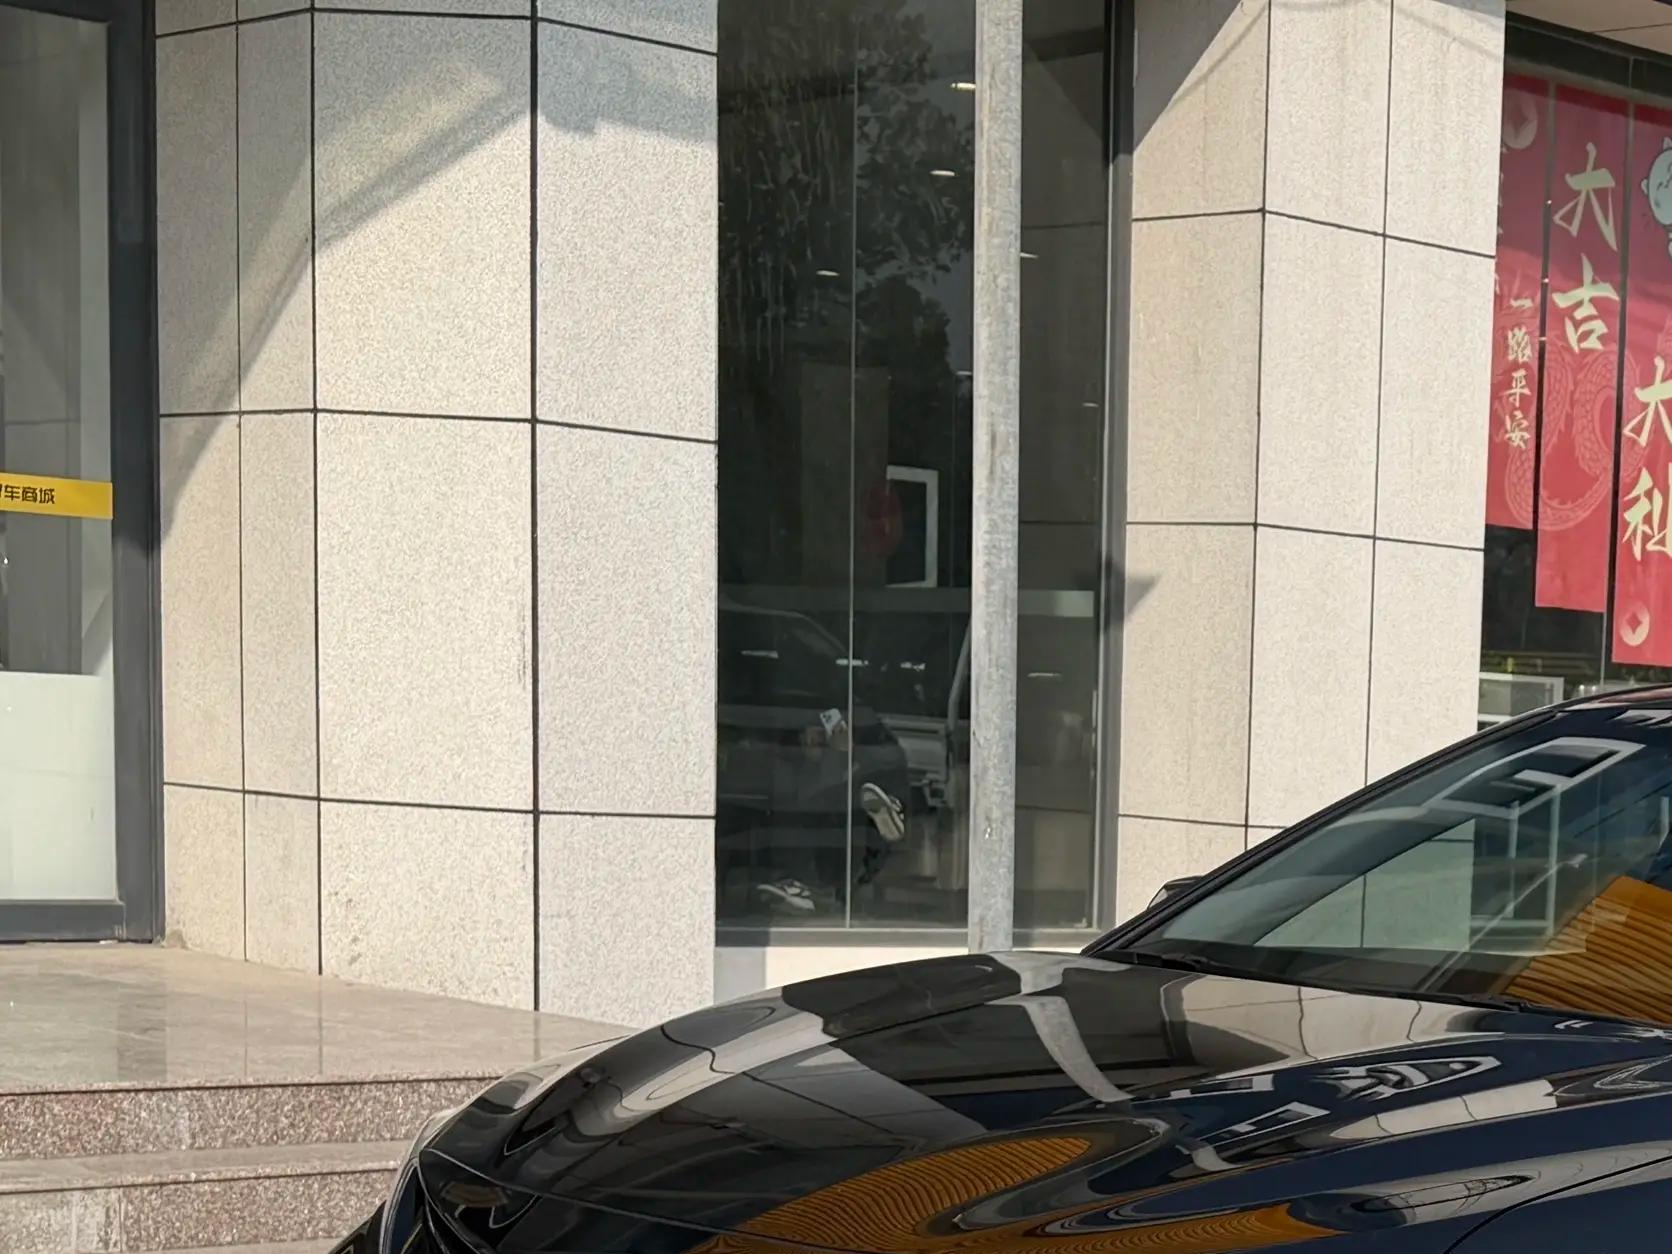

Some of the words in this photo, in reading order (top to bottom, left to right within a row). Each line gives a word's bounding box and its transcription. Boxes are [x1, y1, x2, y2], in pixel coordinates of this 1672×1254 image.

[1552, 141, 1620, 354] 大吉
[1504, 298, 1533, 449] 一路平安
[0, 484, 55, 504] 车商城
